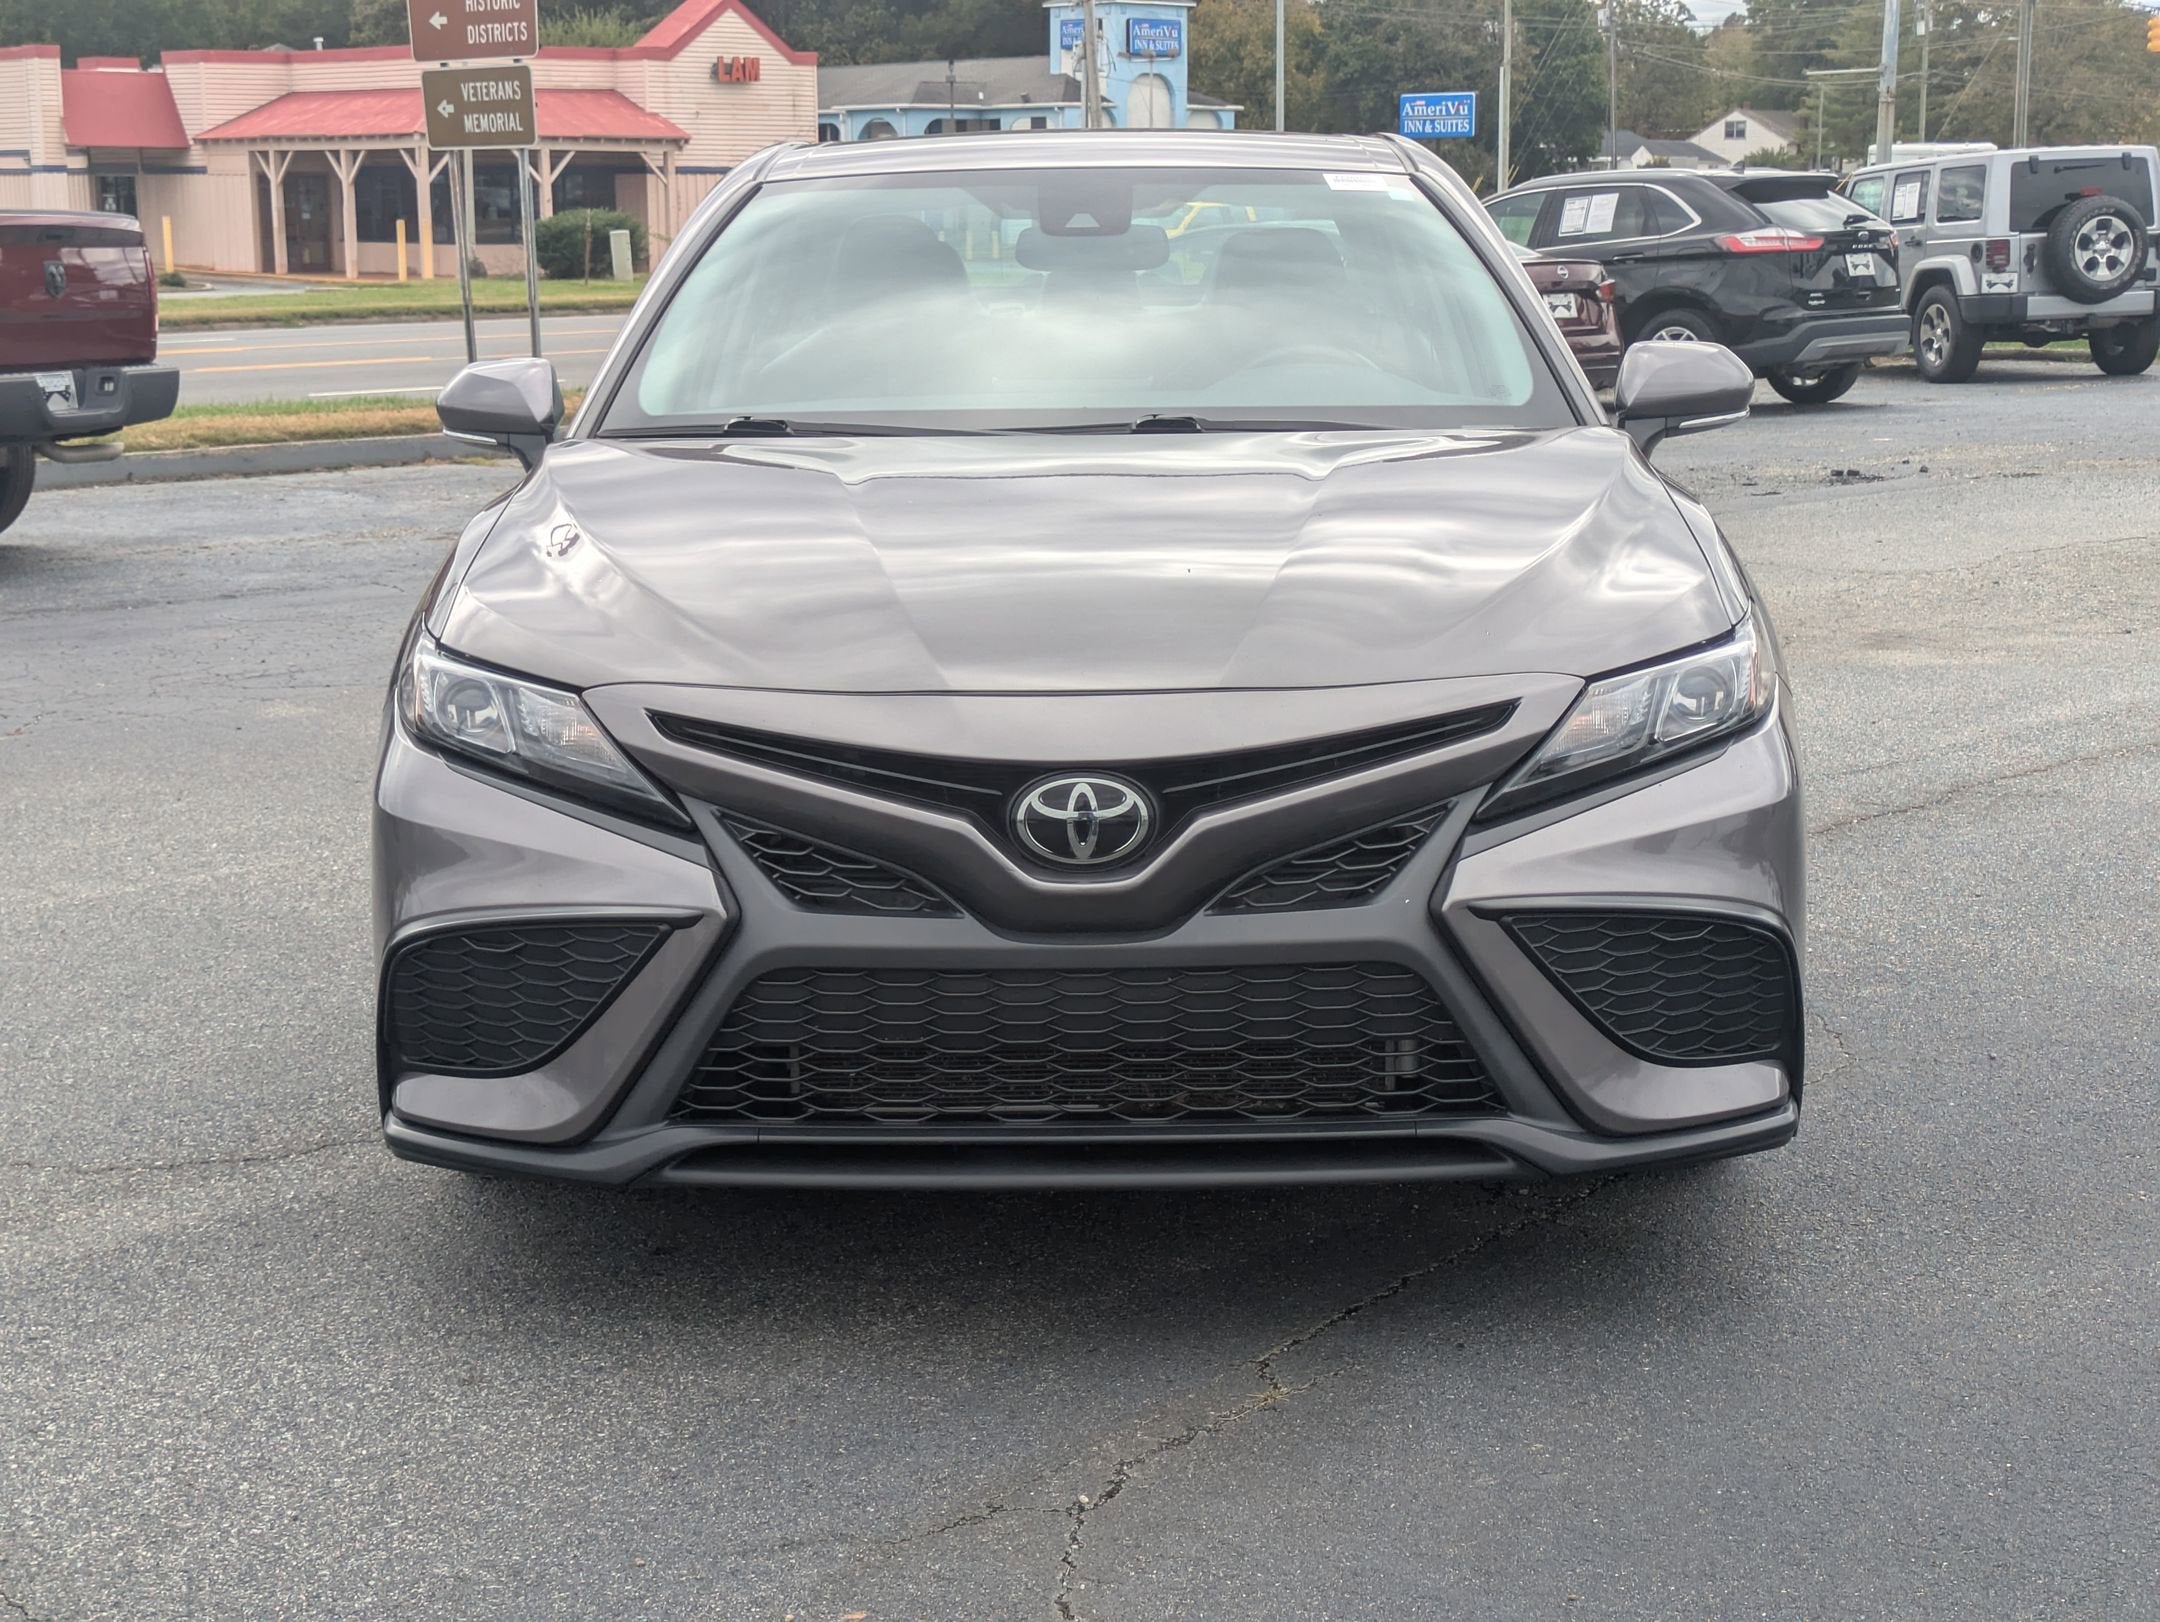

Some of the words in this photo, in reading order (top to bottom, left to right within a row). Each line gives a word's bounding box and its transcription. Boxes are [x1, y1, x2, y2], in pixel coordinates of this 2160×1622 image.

[467, 22, 528, 44] DISTRICTS
[1134, 40, 1148, 50] INN
[1156, 40, 1179, 51] SUITES
[461, 80, 521, 102] VETERANS
[464, 113, 523, 133] MEMORIAL
[1404, 119, 1423, 133] INN
[1424, 119, 1433, 133] &
[1434, 119, 1470, 133] SUITES
